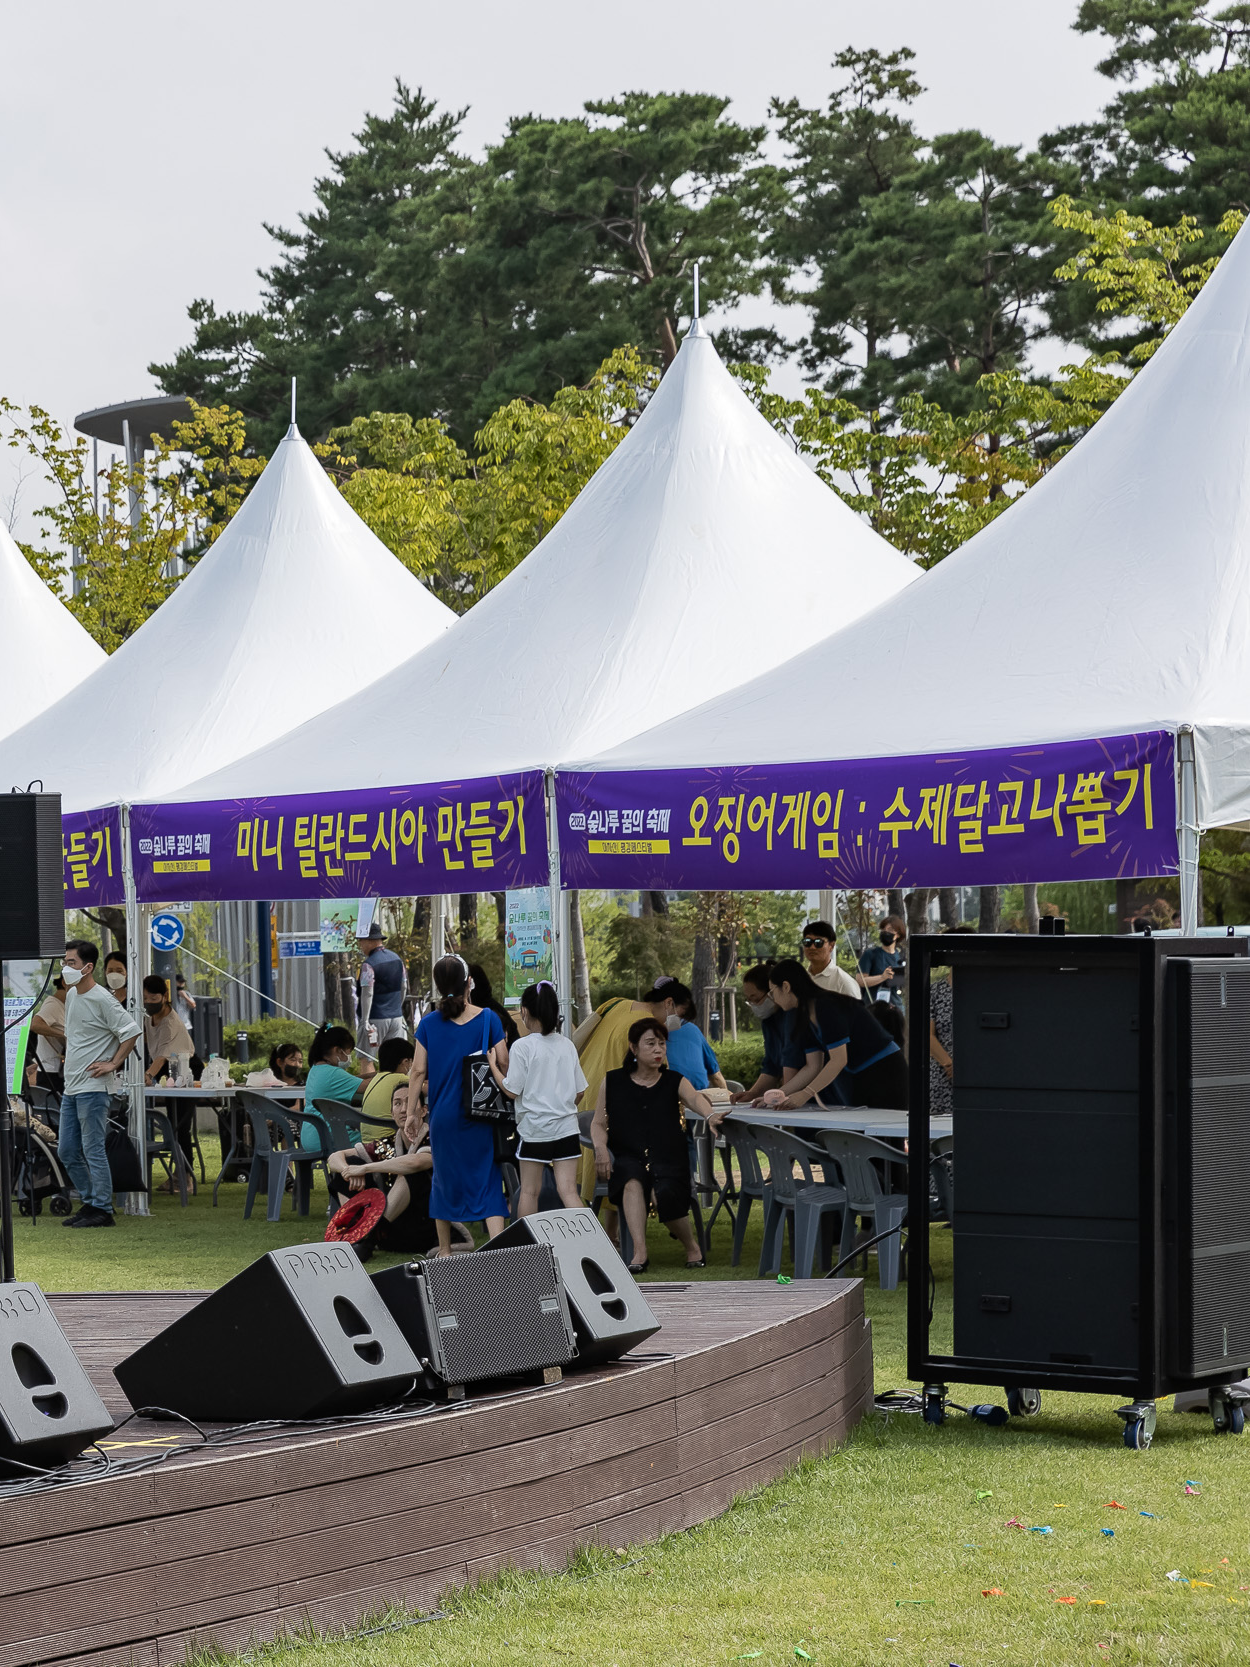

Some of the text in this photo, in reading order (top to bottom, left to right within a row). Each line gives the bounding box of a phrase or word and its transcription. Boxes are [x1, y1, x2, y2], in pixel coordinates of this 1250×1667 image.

[154, 836, 176, 856] 숲나루
[177, 834, 193, 855] 꿈의
[195, 833, 211, 855] 축제
[237, 796, 526, 877] 미니 틸란드시아 만들기
[571, 808, 671, 834] 2022 숲나루 꿈의 축제
[682, 789, 844, 863] 오징어게임
[878, 763, 1153, 853] 수제달고나뽑기
[62, 826, 113, 890] 들기
